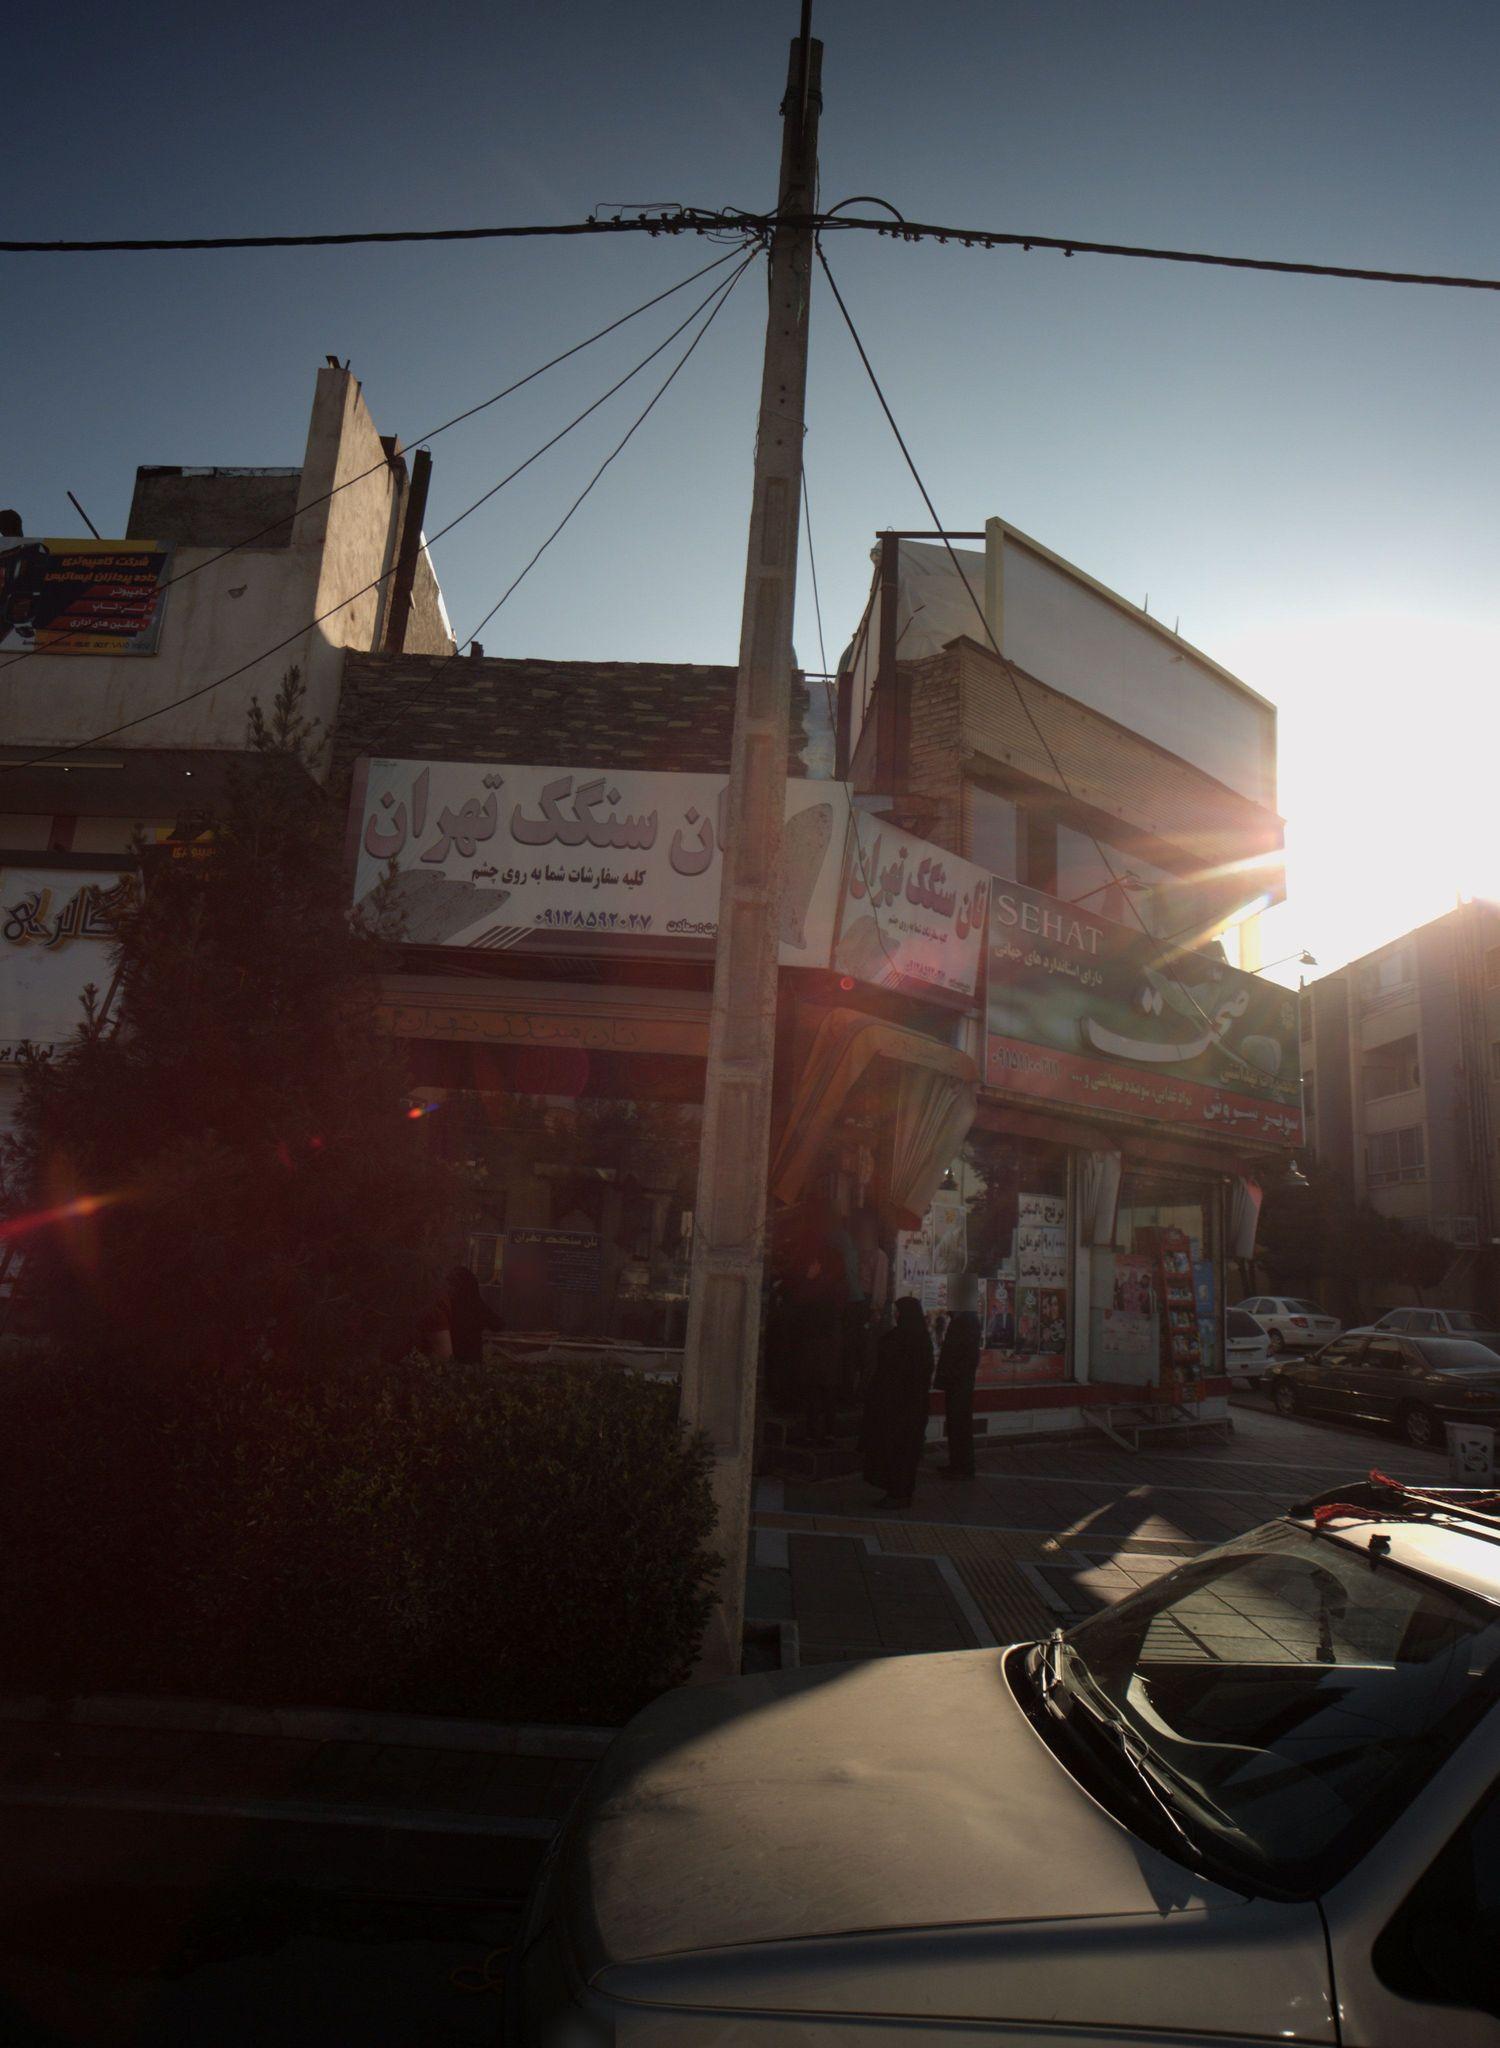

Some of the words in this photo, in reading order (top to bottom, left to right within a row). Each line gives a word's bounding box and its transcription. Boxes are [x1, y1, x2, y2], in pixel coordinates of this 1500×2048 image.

[364, 766, 505, 863] تهران
[510, 775, 658, 850] سنگک
[470, 860, 498, 884] چشم
[501, 868, 528, 885] روی
[530, 869, 542, 885] به
[544, 864, 566, 882] شما
[567, 868, 619, 889] سفارشات
[622, 869, 647, 889] کلیه
[850, 833, 909, 908] تهران
[905, 857, 957, 918] سنگک
[997, 893, 1104, 954] SEHAT
[1080, 968, 1104, 987] دارای
[1261, 1112, 1299, 1137] سوپر
